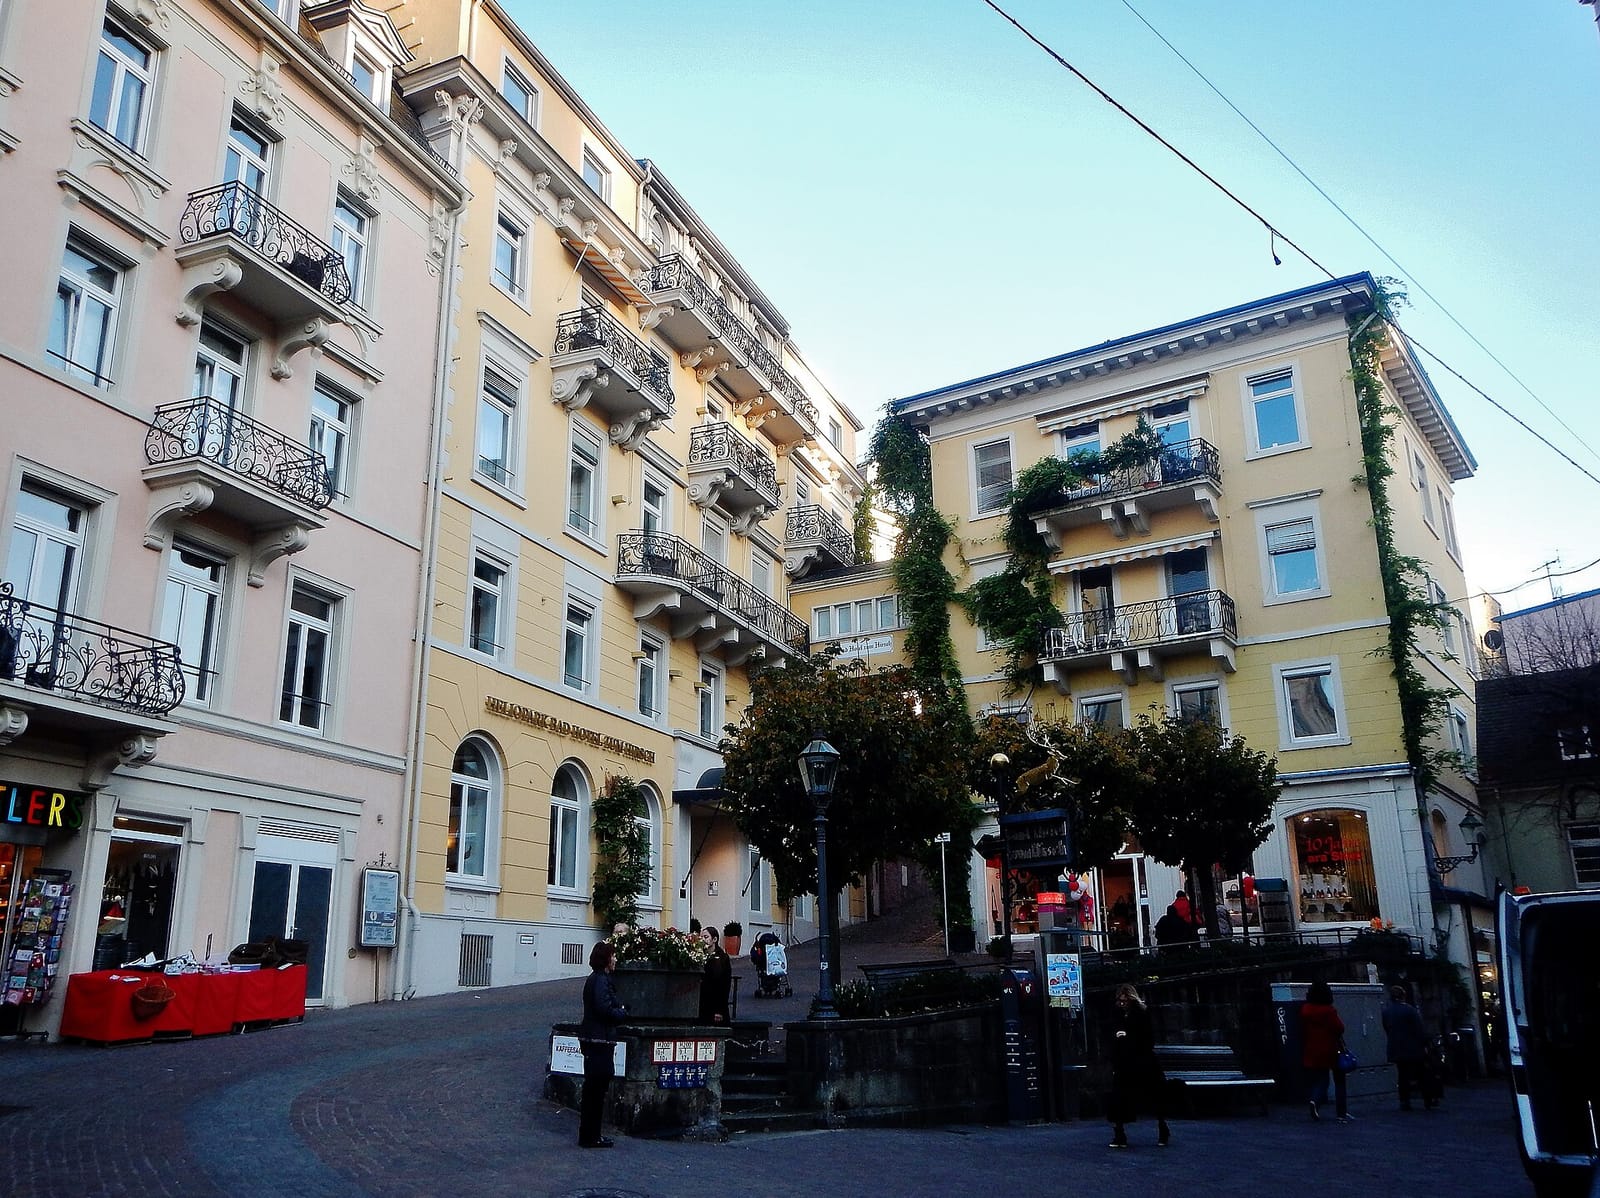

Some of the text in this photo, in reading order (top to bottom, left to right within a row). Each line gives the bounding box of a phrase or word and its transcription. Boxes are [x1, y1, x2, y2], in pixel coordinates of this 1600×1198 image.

[548, 716, 571, 735] BAD
[571, 725, 603, 747] HOTEL
[624, 743, 656, 764] HIRSCH
